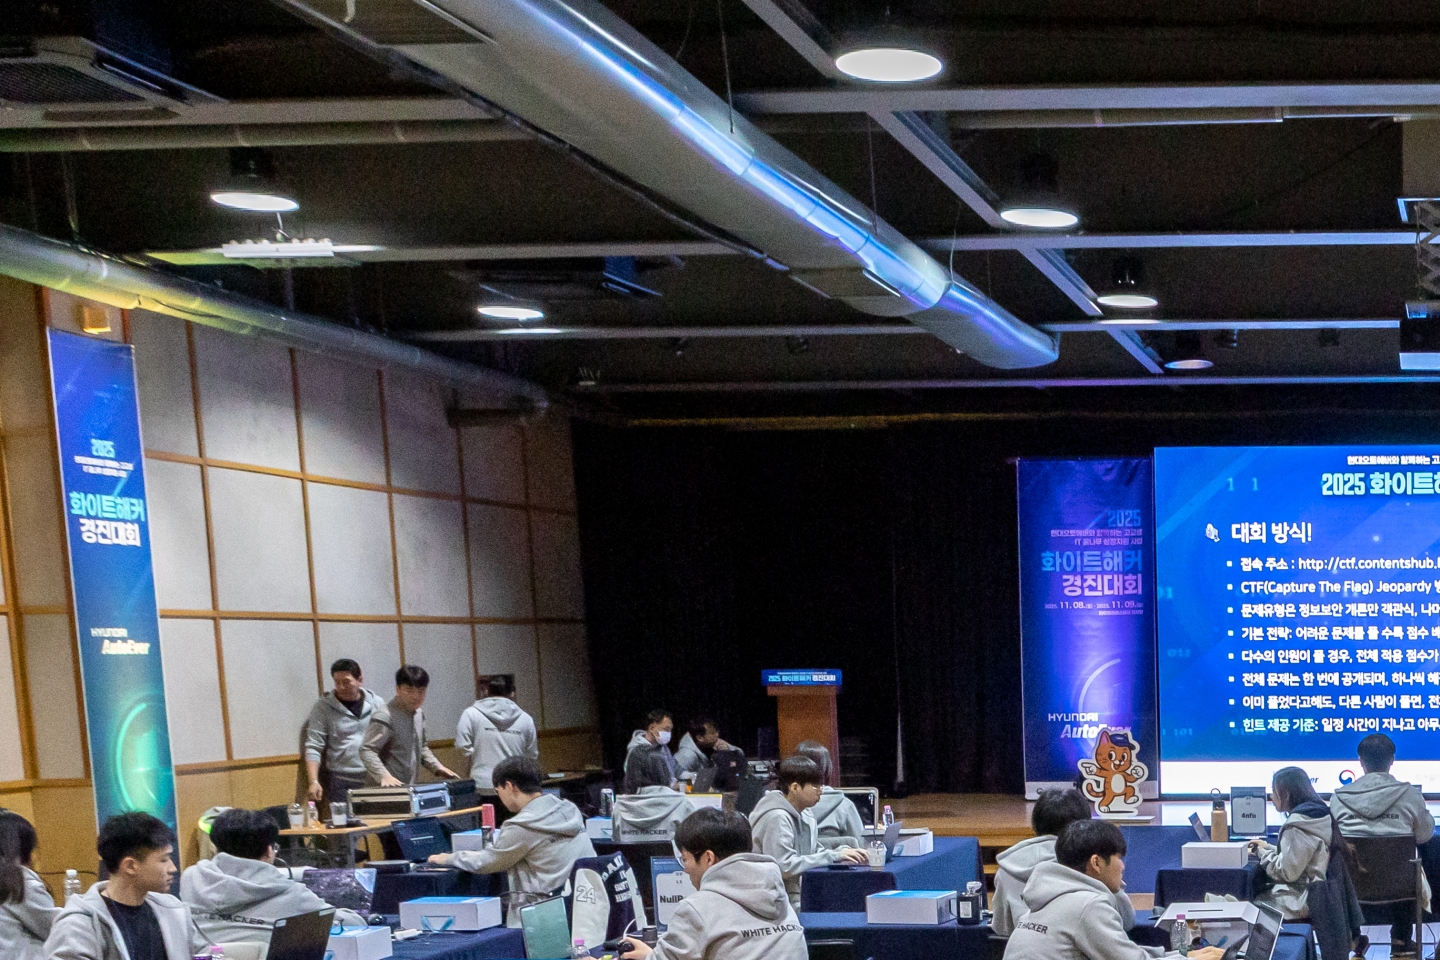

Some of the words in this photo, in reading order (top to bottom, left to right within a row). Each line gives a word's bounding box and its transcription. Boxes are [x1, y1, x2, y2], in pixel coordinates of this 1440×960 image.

[1322, 473, 1365, 496] 2025
[68, 491, 146, 522] 화이트해커
[1108, 510, 1141, 527] 2025
[79, 518, 141, 547] 경진대회
[1232, 522, 1266, 544] 대회
[1272, 522, 1312, 544] 방식!
[1041, 550, 1142, 572] 화이트해커
[1240, 557, 1263, 571] 접속
[1265, 558, 1288, 571] 주소
[1062, 574, 1142, 597] 경진대회
[1240, 580, 1316, 596] CTF(Capture
[1318, 581, 1341, 593] The
[1344, 580, 1373, 595] Flag)
[1376, 580, 1431, 595] Jeopardy
[1241, 603, 1296, 617] 문제유형은
[1299, 603, 1343, 617] 정보보안
[1241, 627, 1264, 640] 기본
[1267, 627, 1292, 640] 전략:
[1296, 626, 1329, 640] 어려운
[1332, 626, 1364, 640] 문제를
[1382, 626, 1403, 640] 수록
[1406, 626, 1429, 639] 점수
[1242, 650, 1275, 663] 다수의
[1278, 650, 1310, 663] 인원이
[1328, 649, 1352, 663] 경우,
[1356, 649, 1378, 663] 전체
[1381, 649, 1403, 663] 적용
[1406, 649, 1439, 662] 점수가
[1242, 673, 1265, 686] 전체
[1267, 672, 1300, 686] 문제는
[1302, 672, 1314, 686] 한
[1317, 672, 1339, 686] 번에
[1341, 672, 1388, 686] 공개되며,
[1392, 672, 1425, 686] 하나씩
[1242, 696, 1264, 709] 이미
[1267, 696, 1336, 710] 풀었다고해도,
[1339, 695, 1362, 709] 다른
[1364, 695, 1396, 709] 사람이
[1048, 713, 1098, 722] HYUNDAI
[1243, 718, 1266, 732] 힌트
[1268, 718, 1290, 732] 제공
[1293, 718, 1318, 732] 기준:
[1322, 718, 1344, 732] 일정
[1346, 718, 1379, 731] 시간이
[1382, 718, 1415, 731] 지나고
[576, 885, 596, 904] 24
[741, 928, 772, 938] WHITE
